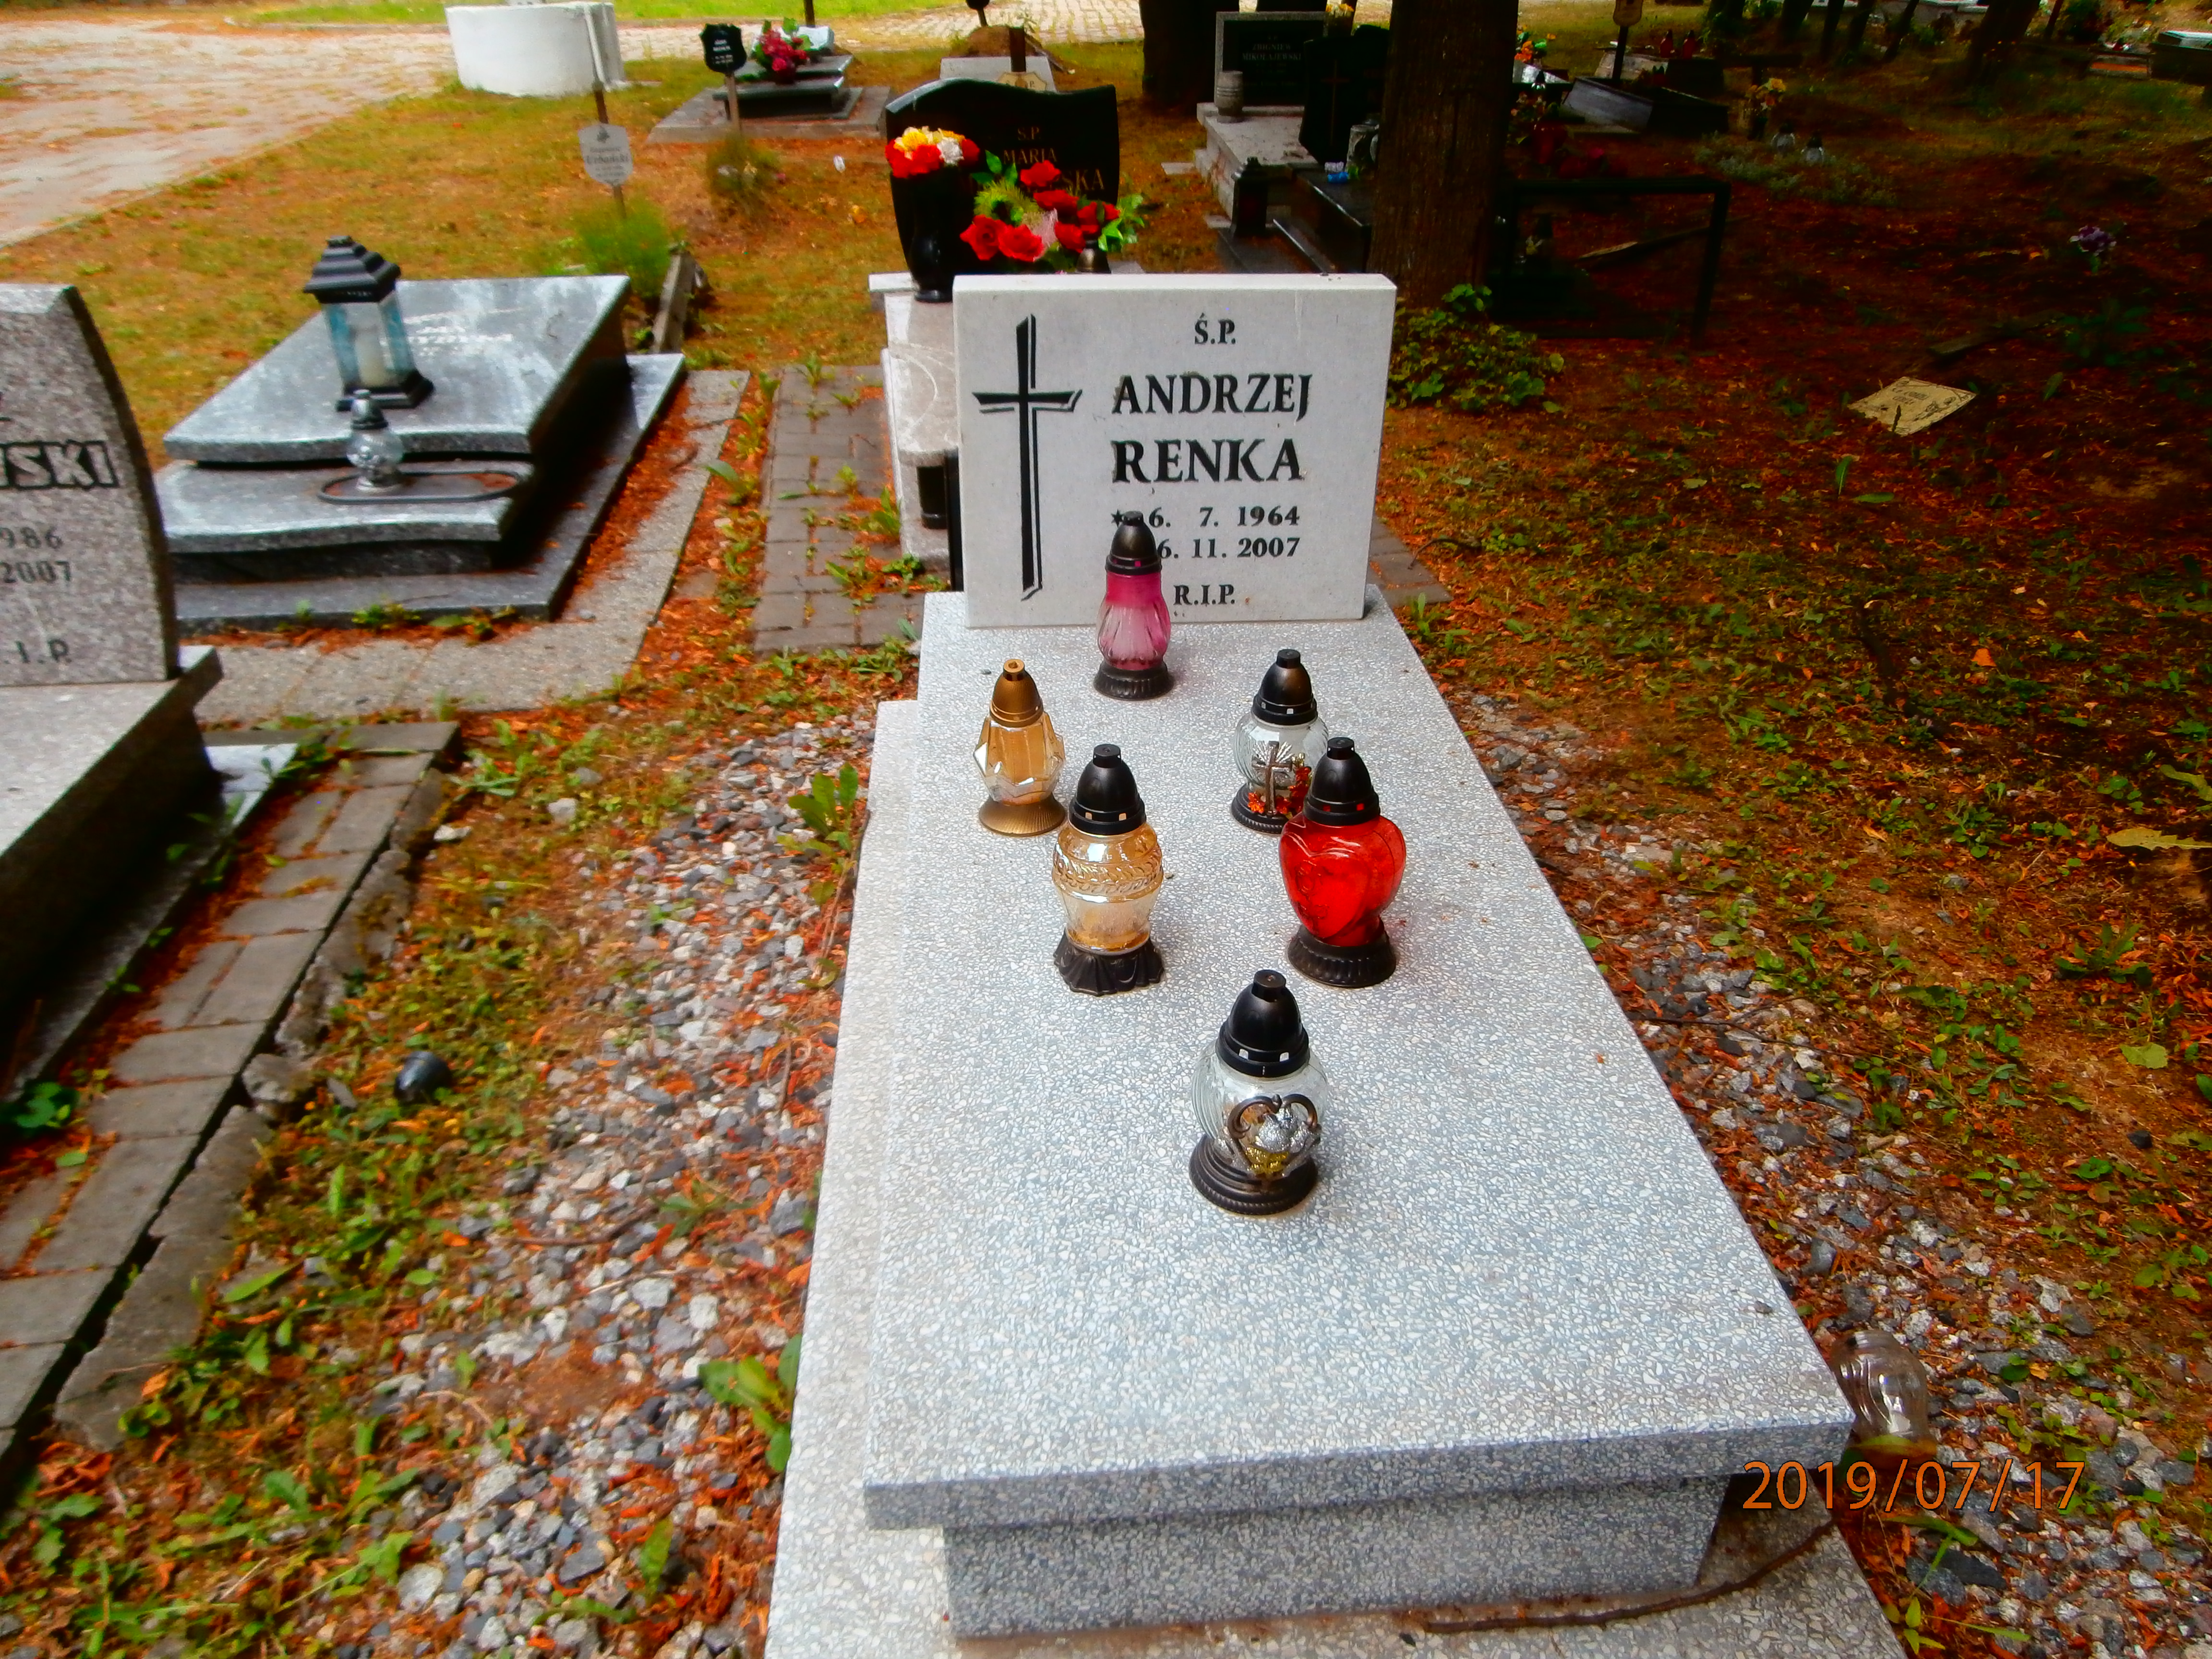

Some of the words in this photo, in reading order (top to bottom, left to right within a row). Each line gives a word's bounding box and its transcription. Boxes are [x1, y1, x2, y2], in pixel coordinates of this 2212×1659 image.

[1003, 147, 1058, 165] MARIA
[1194, 313, 1236, 345] Ś.P.
[1111, 373, 1313, 421] ANDRZEJ
[1111, 439, 1305, 483] RENKA
[1200, 507, 1218, 527] 7.
[1237, 505, 1300, 527] 1964
[1191, 538, 1226, 558] 11.
[1237, 537, 1300, 558] 2007
[1173, 584, 1236, 606] R.I.P.
